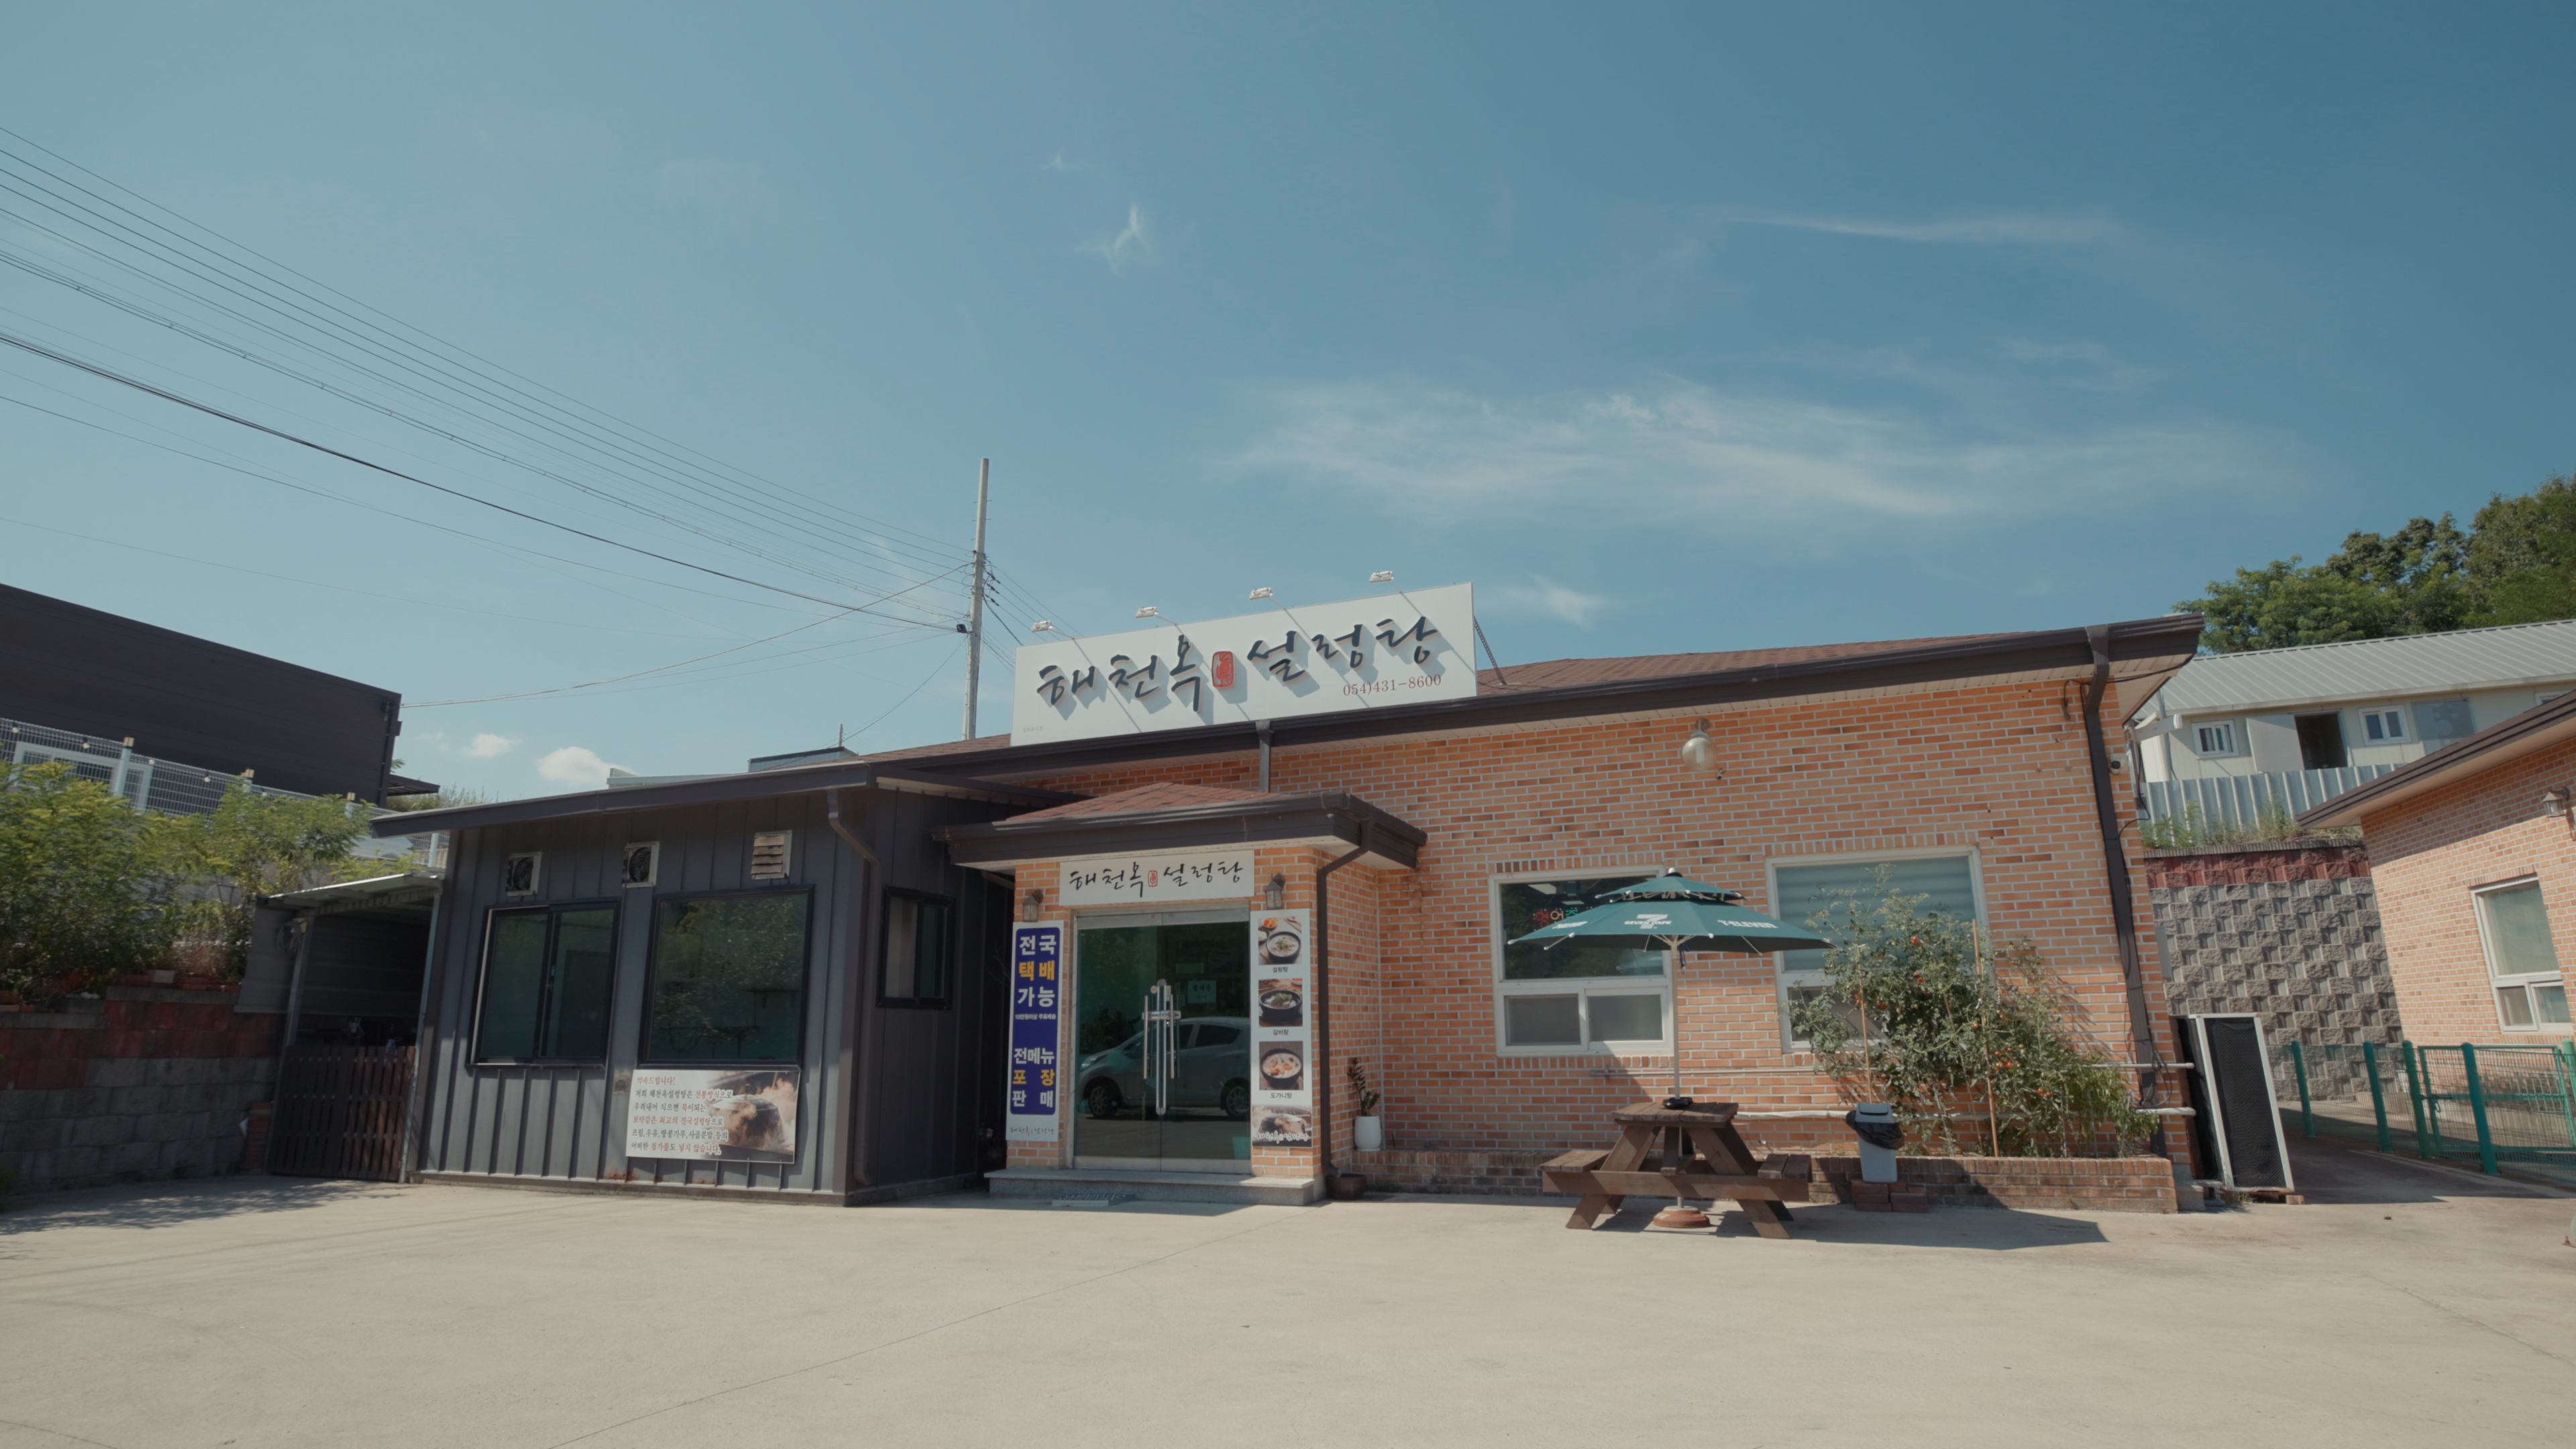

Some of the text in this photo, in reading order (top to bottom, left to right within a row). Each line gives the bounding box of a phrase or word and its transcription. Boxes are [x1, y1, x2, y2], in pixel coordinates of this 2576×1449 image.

[1036, 635, 1203, 712] 해천옥
[1247, 616, 1438, 682] 설렁탕
[1343, 674, 1442, 696] 054)431-8600
[1069, 861, 1143, 898] 해천옥
[1163, 861, 1244, 887] 설렁탕
[1020, 935, 1057, 955] 전국
[1019, 960, 1055, 981] 택배
[1018, 987, 1055, 1007] 가능
[1014, 1047, 1055, 1065] 전메뉴
[637, 1077, 676, 1085] 약속드립니다!
[1012, 1069, 1055, 1086] 포장
[635, 1089, 733, 1099] 저희 해천옥설렁탕은 전통방식으로
[1012, 1090, 1053, 1108] 판매
[634, 1103, 658, 1111] 우려내어
[660, 1103, 679, 1112] 식으면
[633, 1116, 723, 1126] 보약같은 최고의 진국설렁탕으로
[715, 1131, 728, 1140] 등의
[631, 1142, 720, 1153] 어떠한 첨가물도 넣지 않습니다.
